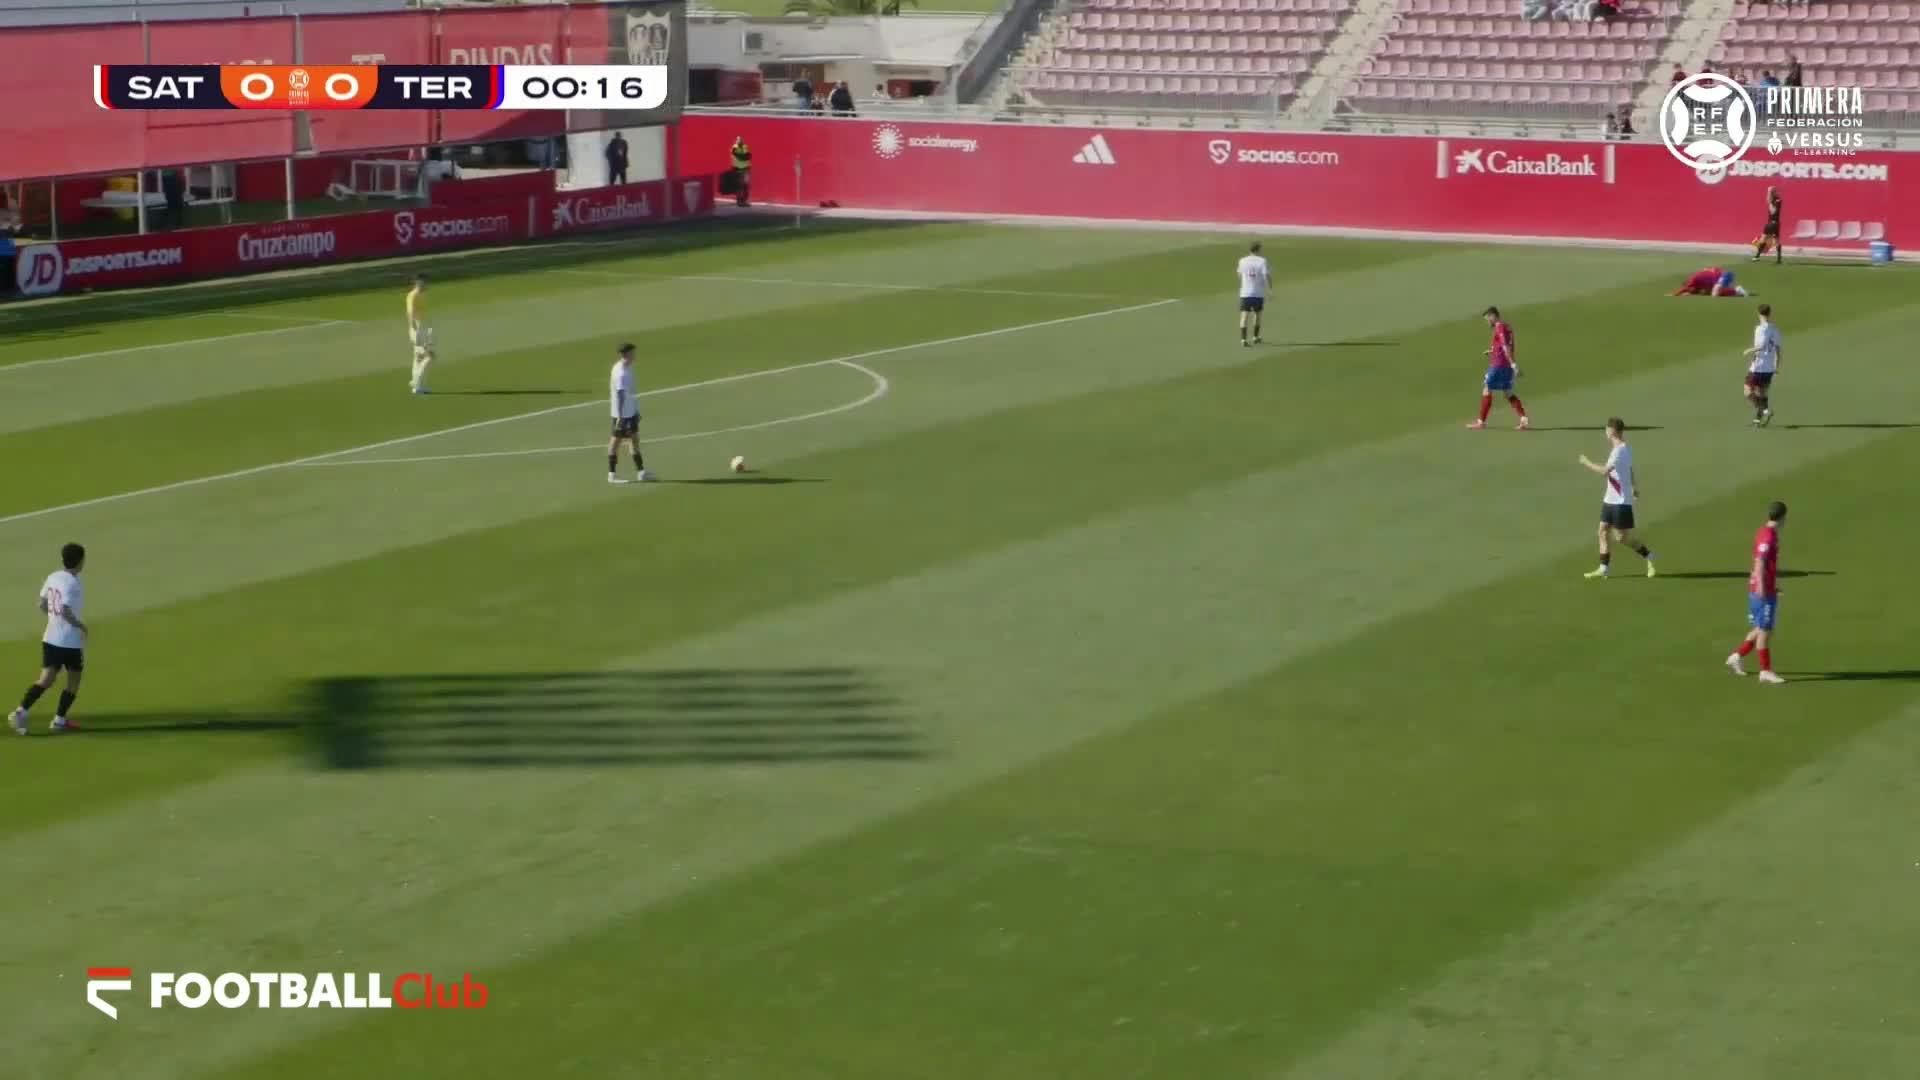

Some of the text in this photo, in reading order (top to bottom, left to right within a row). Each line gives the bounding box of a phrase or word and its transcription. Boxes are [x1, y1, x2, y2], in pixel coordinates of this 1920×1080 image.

[1487, 151, 1597, 176] CaixaBank
[575, 192, 650, 224] CaixaBank
[65, 247, 182, 275] JDSPORTS.COM
[237, 230, 335, 262] Cruzcampo
[23, 253, 56, 287] JD
